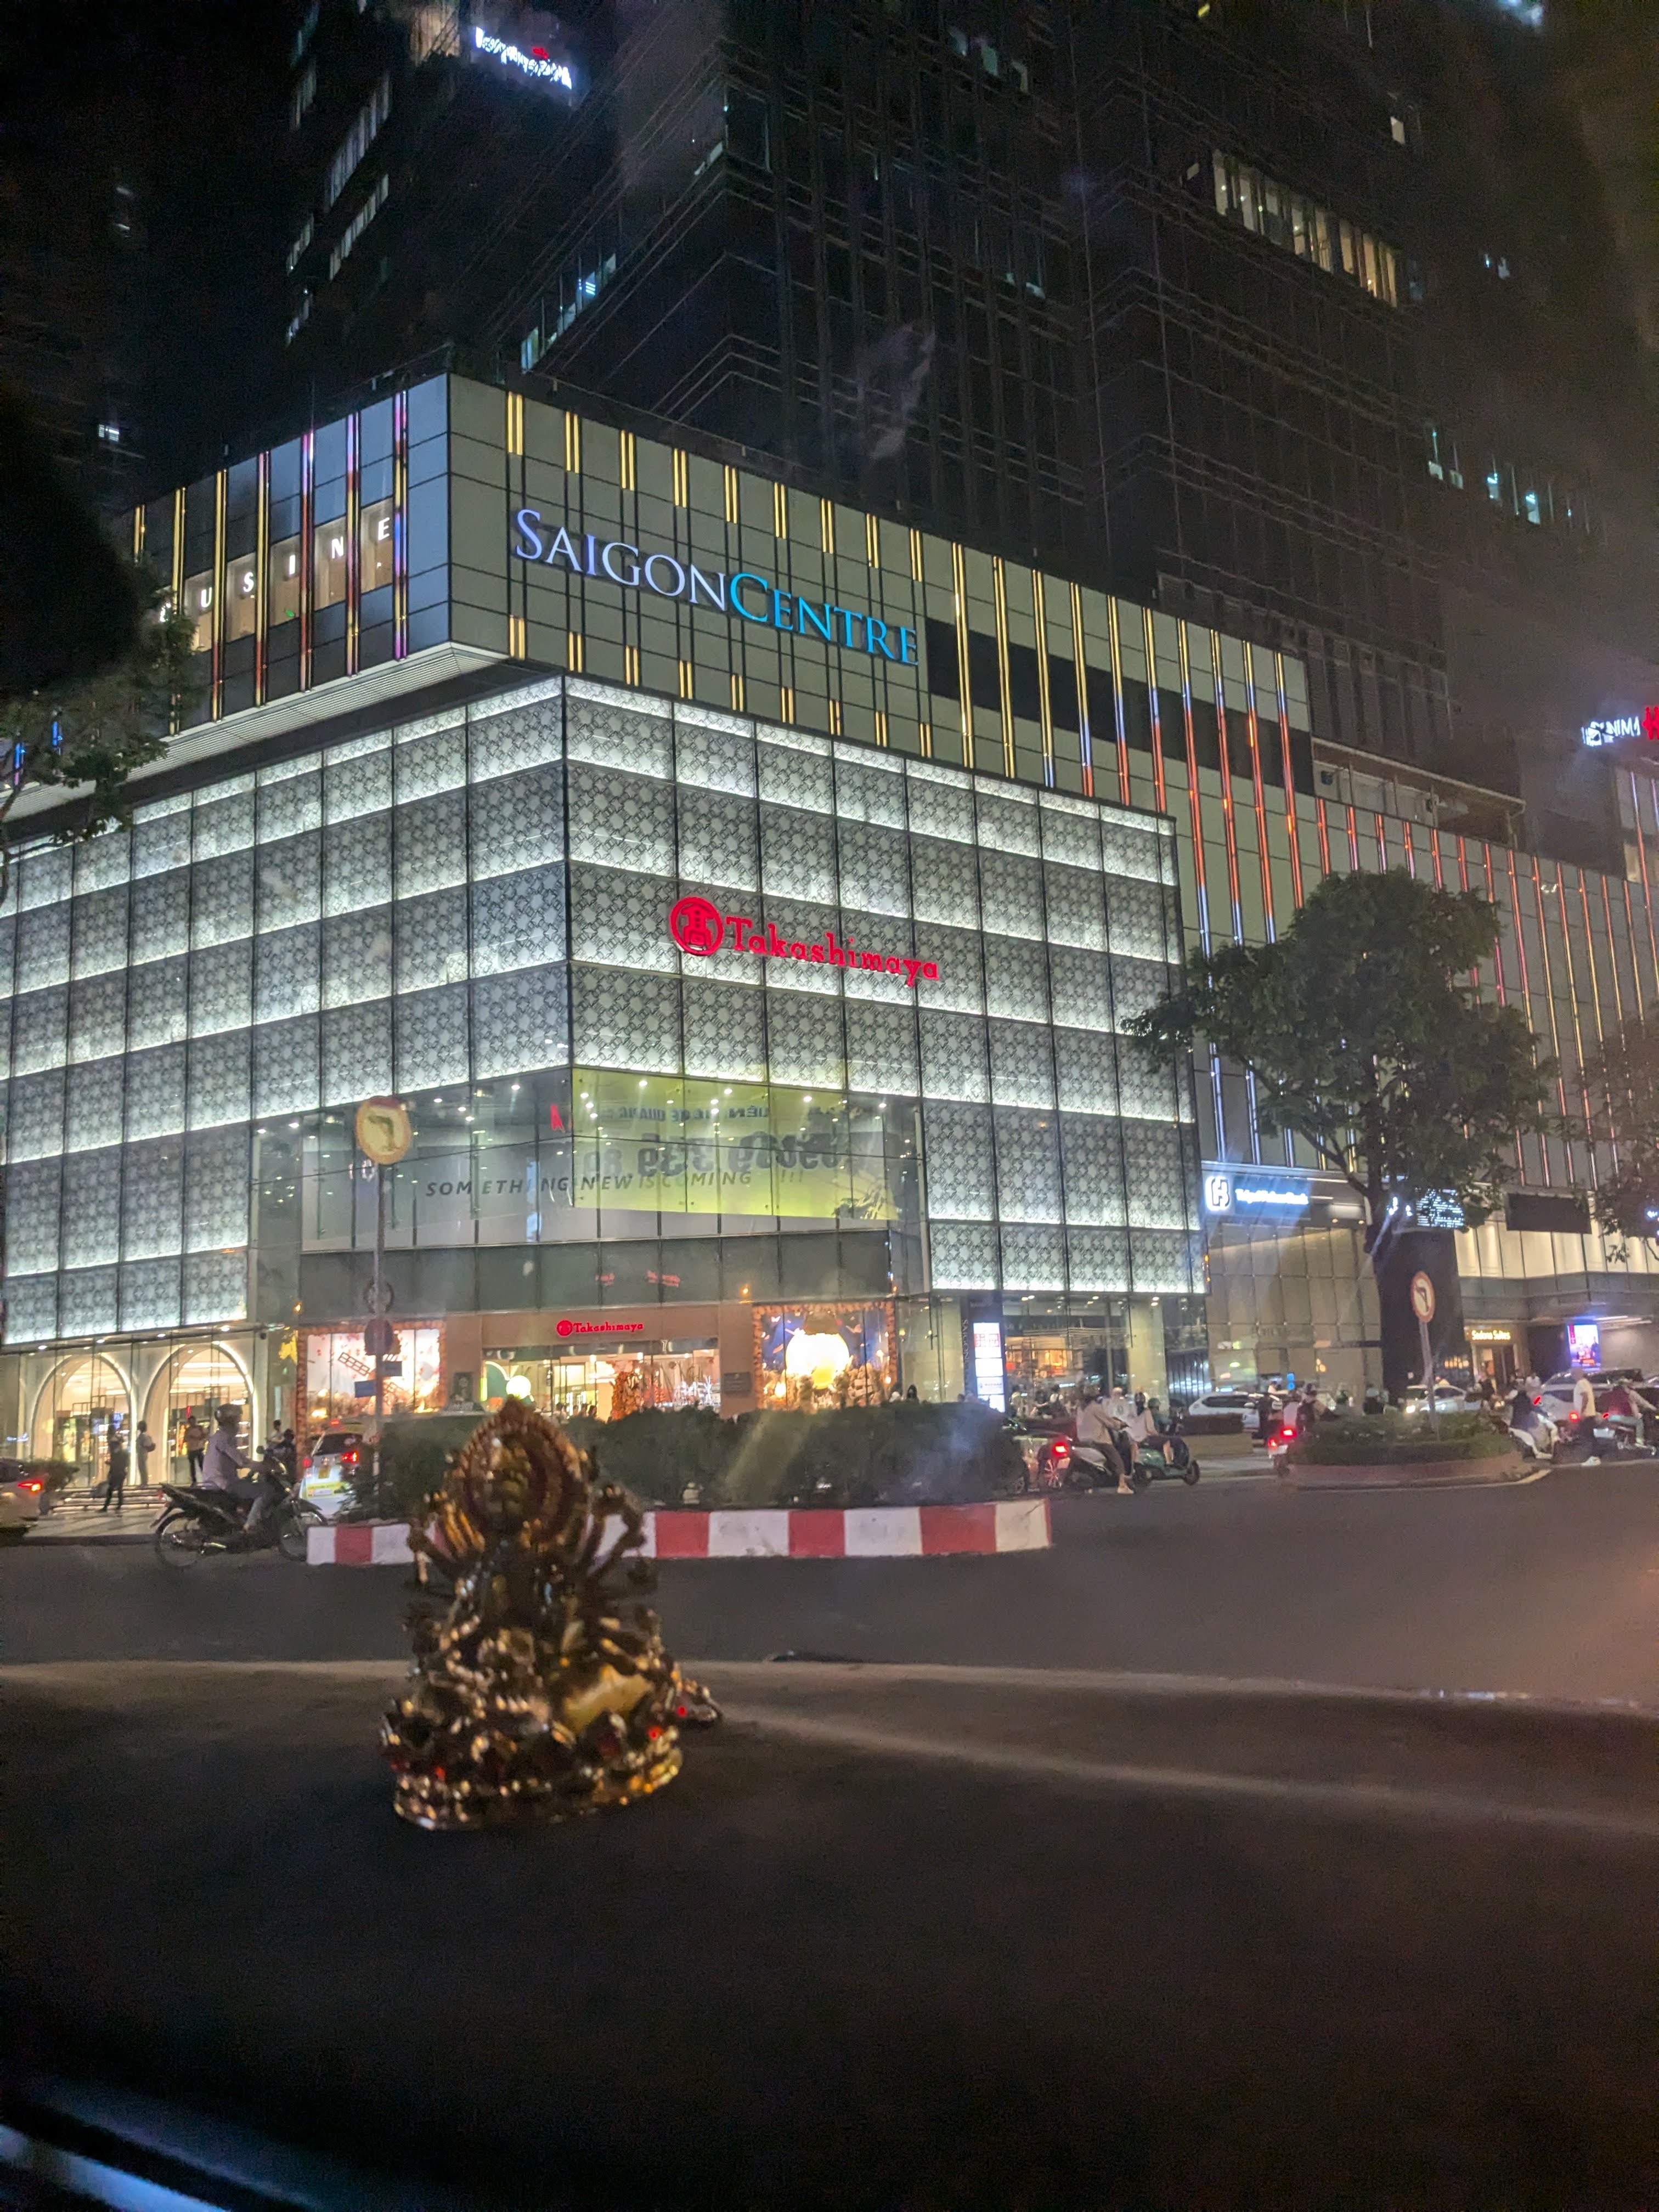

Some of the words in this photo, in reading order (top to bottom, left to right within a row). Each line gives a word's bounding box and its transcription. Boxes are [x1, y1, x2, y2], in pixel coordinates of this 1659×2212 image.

[726, 916, 940, 988] Takashimaya
[426, 1177, 569, 1197] SOMETHING
[580, 1173, 633, 1190] NEW
[573, 1321, 644, 1333] Takashimaya
